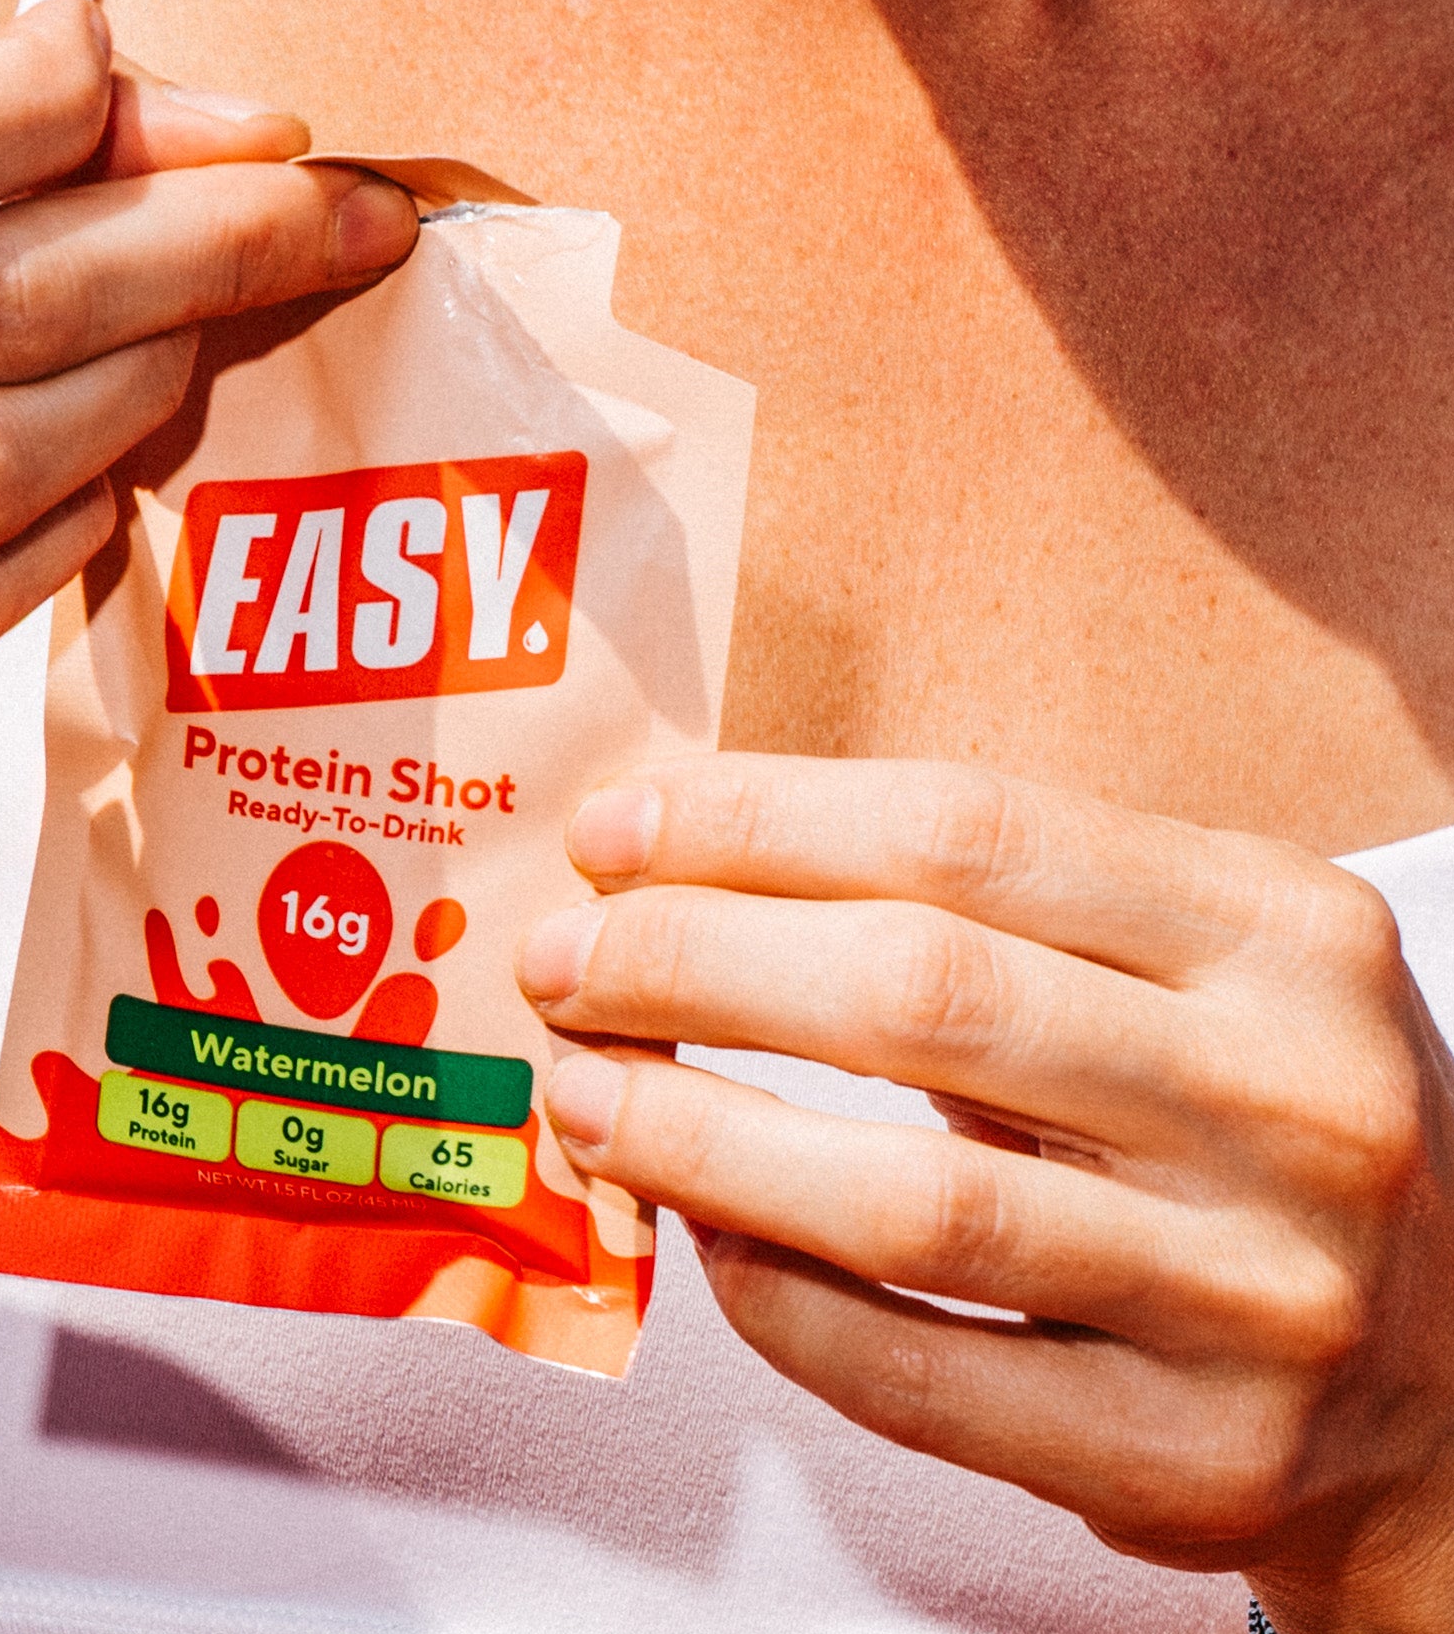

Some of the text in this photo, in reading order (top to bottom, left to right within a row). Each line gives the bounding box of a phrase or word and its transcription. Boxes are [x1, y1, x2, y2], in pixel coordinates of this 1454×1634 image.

[183, 724, 516, 813] Protein Shot
[227, 790, 465, 846] Ready-To-Drink
[281, 891, 369, 956] 16g
[190, 1030, 437, 1101] Watermelon
[139, 1088, 190, 1128] 16g
[129, 1122, 196, 1150] Protein
[282, 1116, 325, 1152] 0g
[274, 1150, 329, 1175] Sugar
[431, 1140, 474, 1168] 65
[197, 1170, 232, 1186] NET
[274, 1182, 296, 1197] 1.5
[300, 1185, 323, 1202] FL
[326, 1190, 353, 1204] OZ
[409, 1172, 491, 1198] Calories
